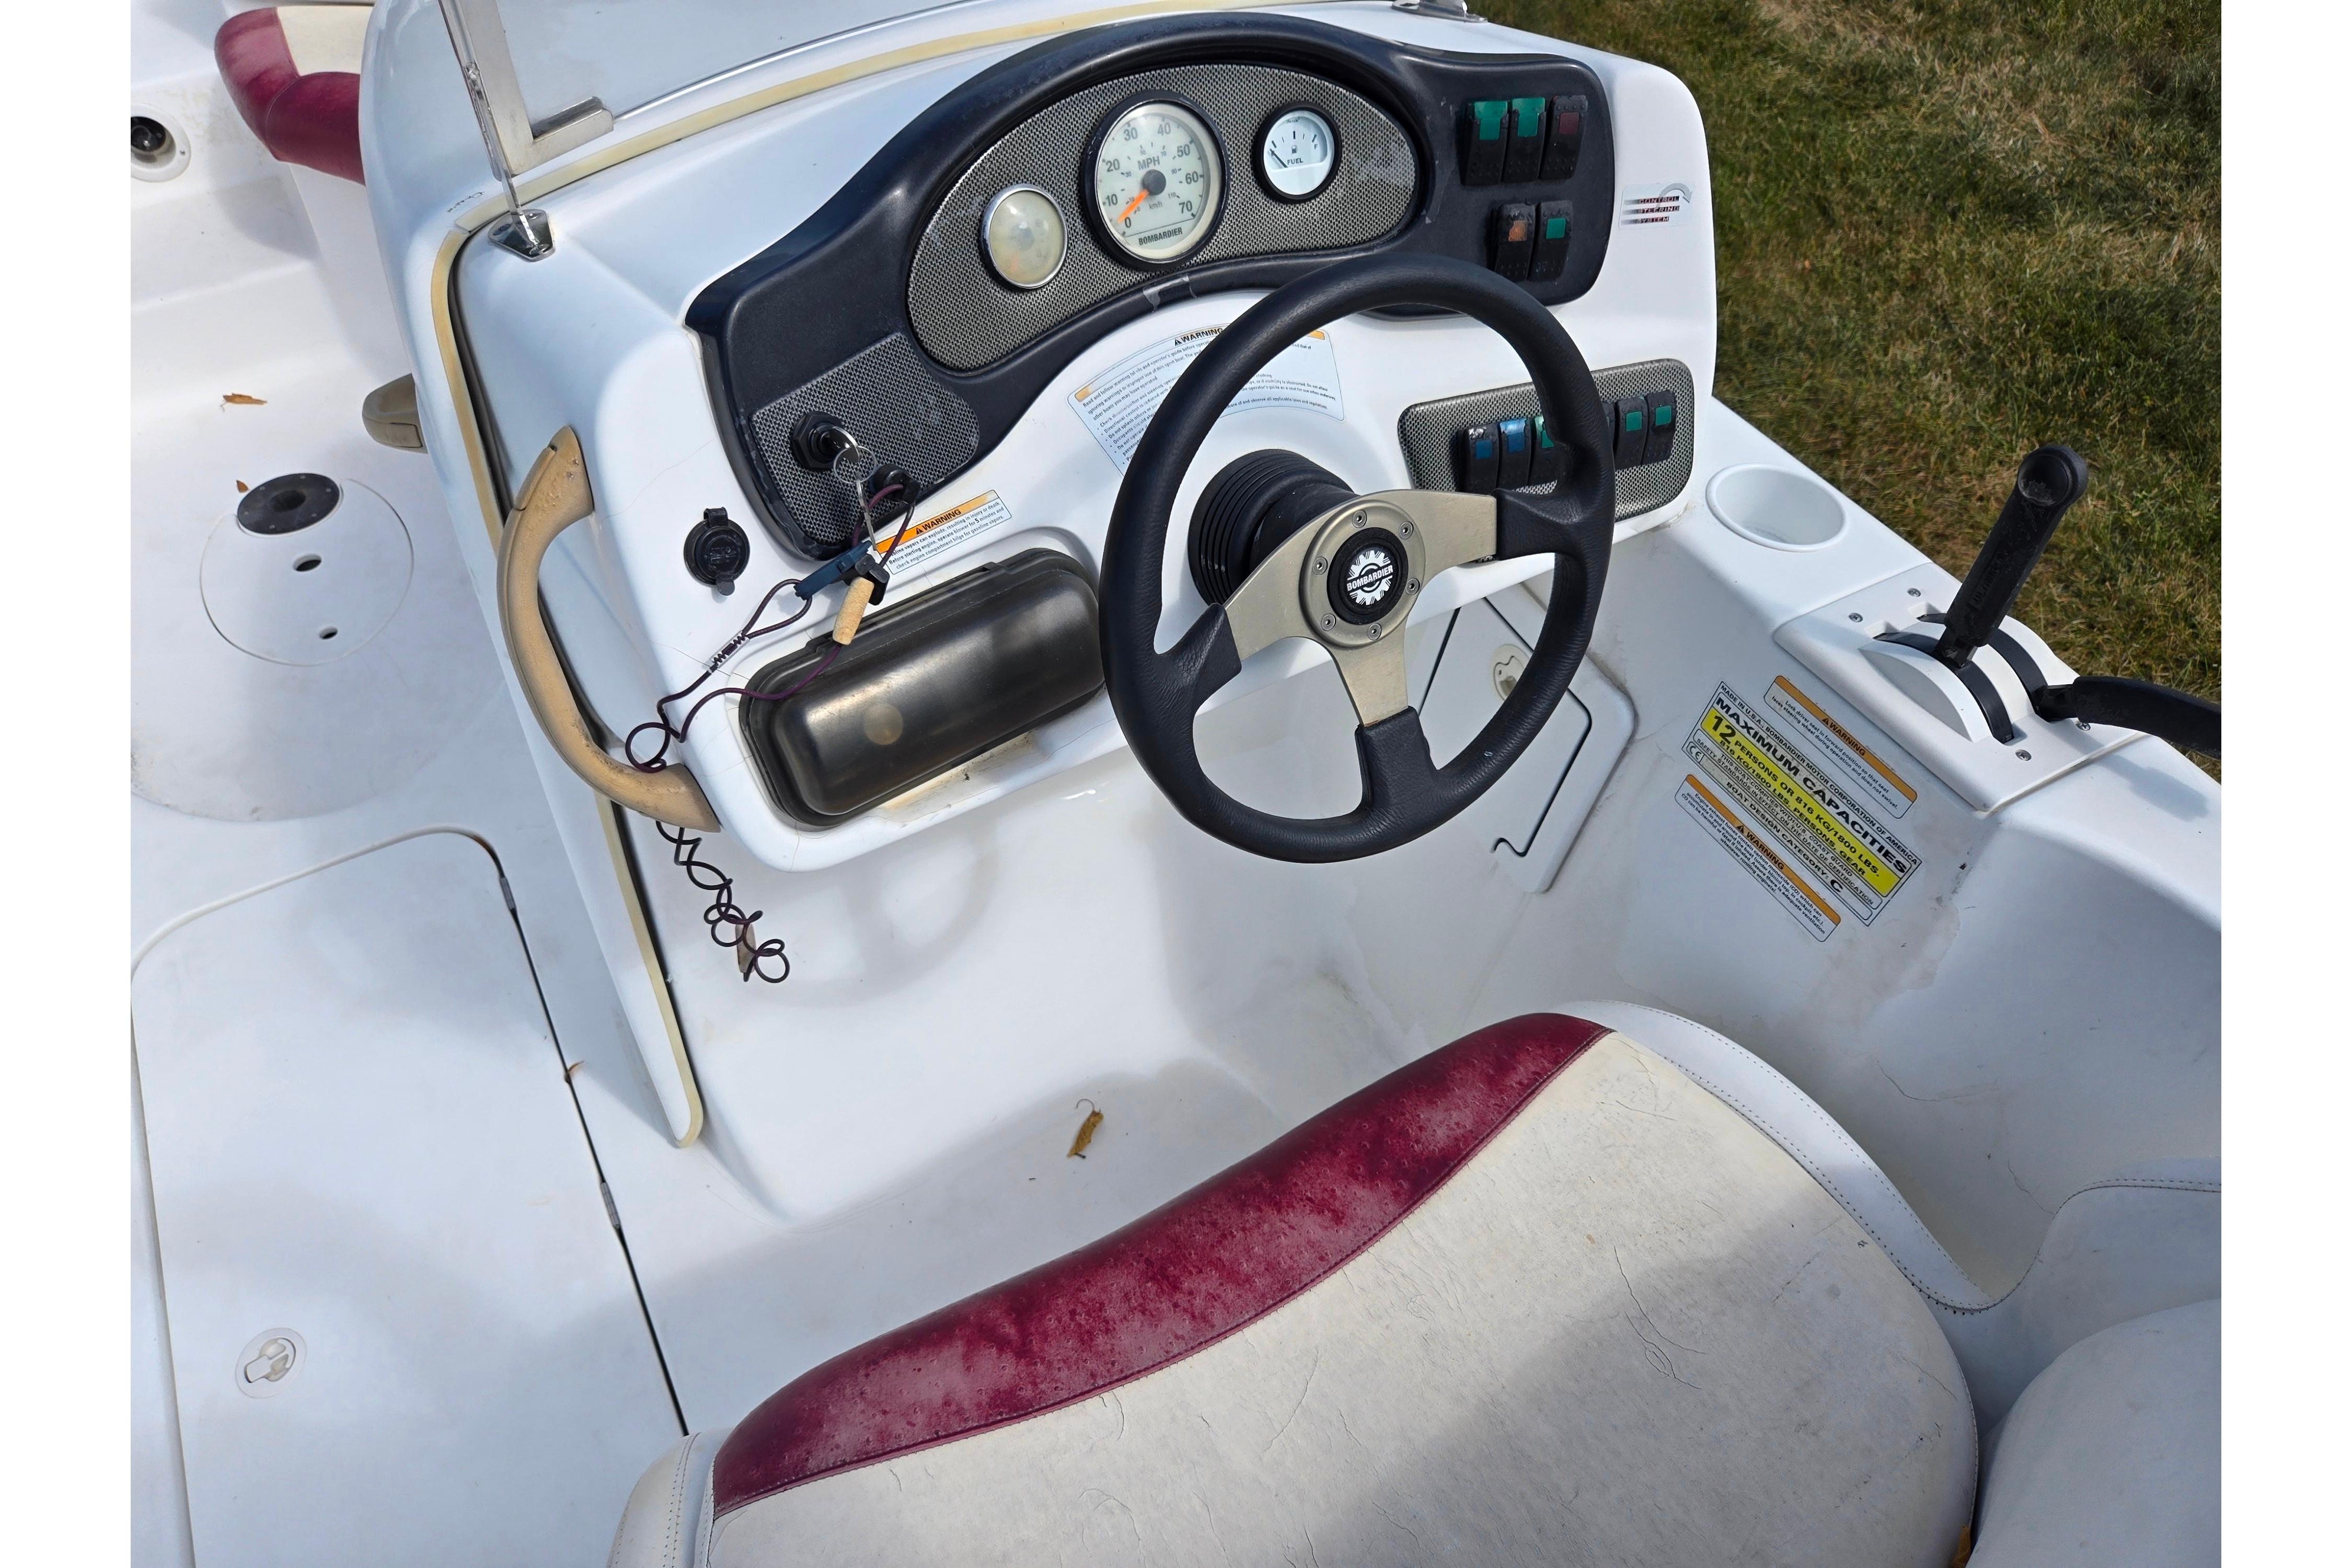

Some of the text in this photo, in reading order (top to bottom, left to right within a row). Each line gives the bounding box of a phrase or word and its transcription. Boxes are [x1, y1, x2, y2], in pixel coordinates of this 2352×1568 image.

[1124, 128, 1138, 141] 30
[1157, 122, 1171, 136] 40
[1106, 158, 1120, 172] 20
[1137, 156, 1160, 170] MPH
[1177, 144, 1190, 157] 50
[1185, 171, 1198, 185] 60
[1106, 194, 1117, 206] 10
[1149, 201, 1162, 210] km/h
[1179, 200, 1193, 213] 70
[1124, 217, 1131, 228] 0
[1138, 227, 1183, 246] BOMBARDIER
[1181, 328, 1223, 343] WARNING
[922, 509, 961, 530] WARNING
[889, 555, 904, 564] Before
[903, 547, 921, 558] starting
[937, 531, 954, 541] operate
[953, 524, 969, 533] blower
[979, 511, 996, 521] minutes
[1346, 565, 1393, 591] BOMBARDIER
[1688, 744, 1701, 759] CE
[1772, 696, 1783, 708] faces
[1783, 706, 1801, 724] steering
[1801, 722, 1815, 735] wheel
[1814, 734, 1829, 749] during
[1829, 747, 1852, 768] operation
[1852, 767, 1861, 776] and
[1861, 775, 1873, 786] does
[1873, 785, 1881, 794] not
[1785, 700, 1796, 711] Lock
[1796, 710, 1809, 723] driver
[1809, 721, 1819, 731] seat
[1825, 735, 1842, 752] forward
[1842, 751, 1861, 769] position
[1868, 773, 1878, 783] that
[1878, 782, 1889, 793] seat
[1829, 722, 1865, 756] WARNING
[1716, 697, 1907, 874] MAXIMUM CAPACITIES
[1720, 685, 1737, 702] MADE
[1738, 701, 1745, 709] IN
[1765, 726, 1805, 764] BOMBARDIER
[1805, 762, 1829, 785] MOTOR
[1828, 783, 1876, 827] CORPORATION
[1875, 826, 1886, 836] OF
[1885, 835, 1918, 865] AMERICA
[1709, 713, 1881, 877] 12 PERSONS OR 816 KG/1800 LBS.
[1720, 739, 1865, 875] 816 KG/1800 LBS. PERSONS, GEAR
[1697, 738, 1716, 758] SAFETY
[1717, 757, 1750, 790] STANDARDS
[1758, 796, 1779, 817] EFFECT
[1780, 816, 1789, 826] ON
[1790, 826, 1801, 838] THE
[1802, 837, 1818, 854] DATE
[1819, 853, 1827, 862] OF
[1828, 862, 1873, 905] CERTIFICATION
[1721, 753, 1852, 877] THIS BOAT COMPLIES WITH U.S. COAST GUARD
[1687, 791, 1709, 814] accumulate
[1722, 825, 1736, 841] around
[1744, 847, 1754, 858] boat
[1754, 857, 1767, 871] (under
[1781, 884, 1790, 894] top,
[1795, 897, 1813, 915] cockpit,
[1695, 793, 1709, 808] Engine
[1709, 806, 1725, 823] exhaust
[1725, 822, 1737, 835] fumes
[1738, 834, 1754, 850] contain
[1754, 849, 1768, 864] carbon
[1768, 863, 1789, 885] monoxide
[1800, 894, 1813, 908] which
[1726, 781, 1843, 893] BOAT DESIGN CATEGORY: C
[1746, 831, 1784, 870] WARNING
[1701, 812, 1716, 829] harmful
[1722, 832, 1731, 842] fatal
[1751, 861, 1766, 876] Assure
[1766, 875, 1777, 887] there
[1782, 891, 1802, 912] adequate
[1802, 910, 1825, 933] ventilation
[1720, 837, 1739, 857] whenever
[1739, 857, 1756, 874] running
